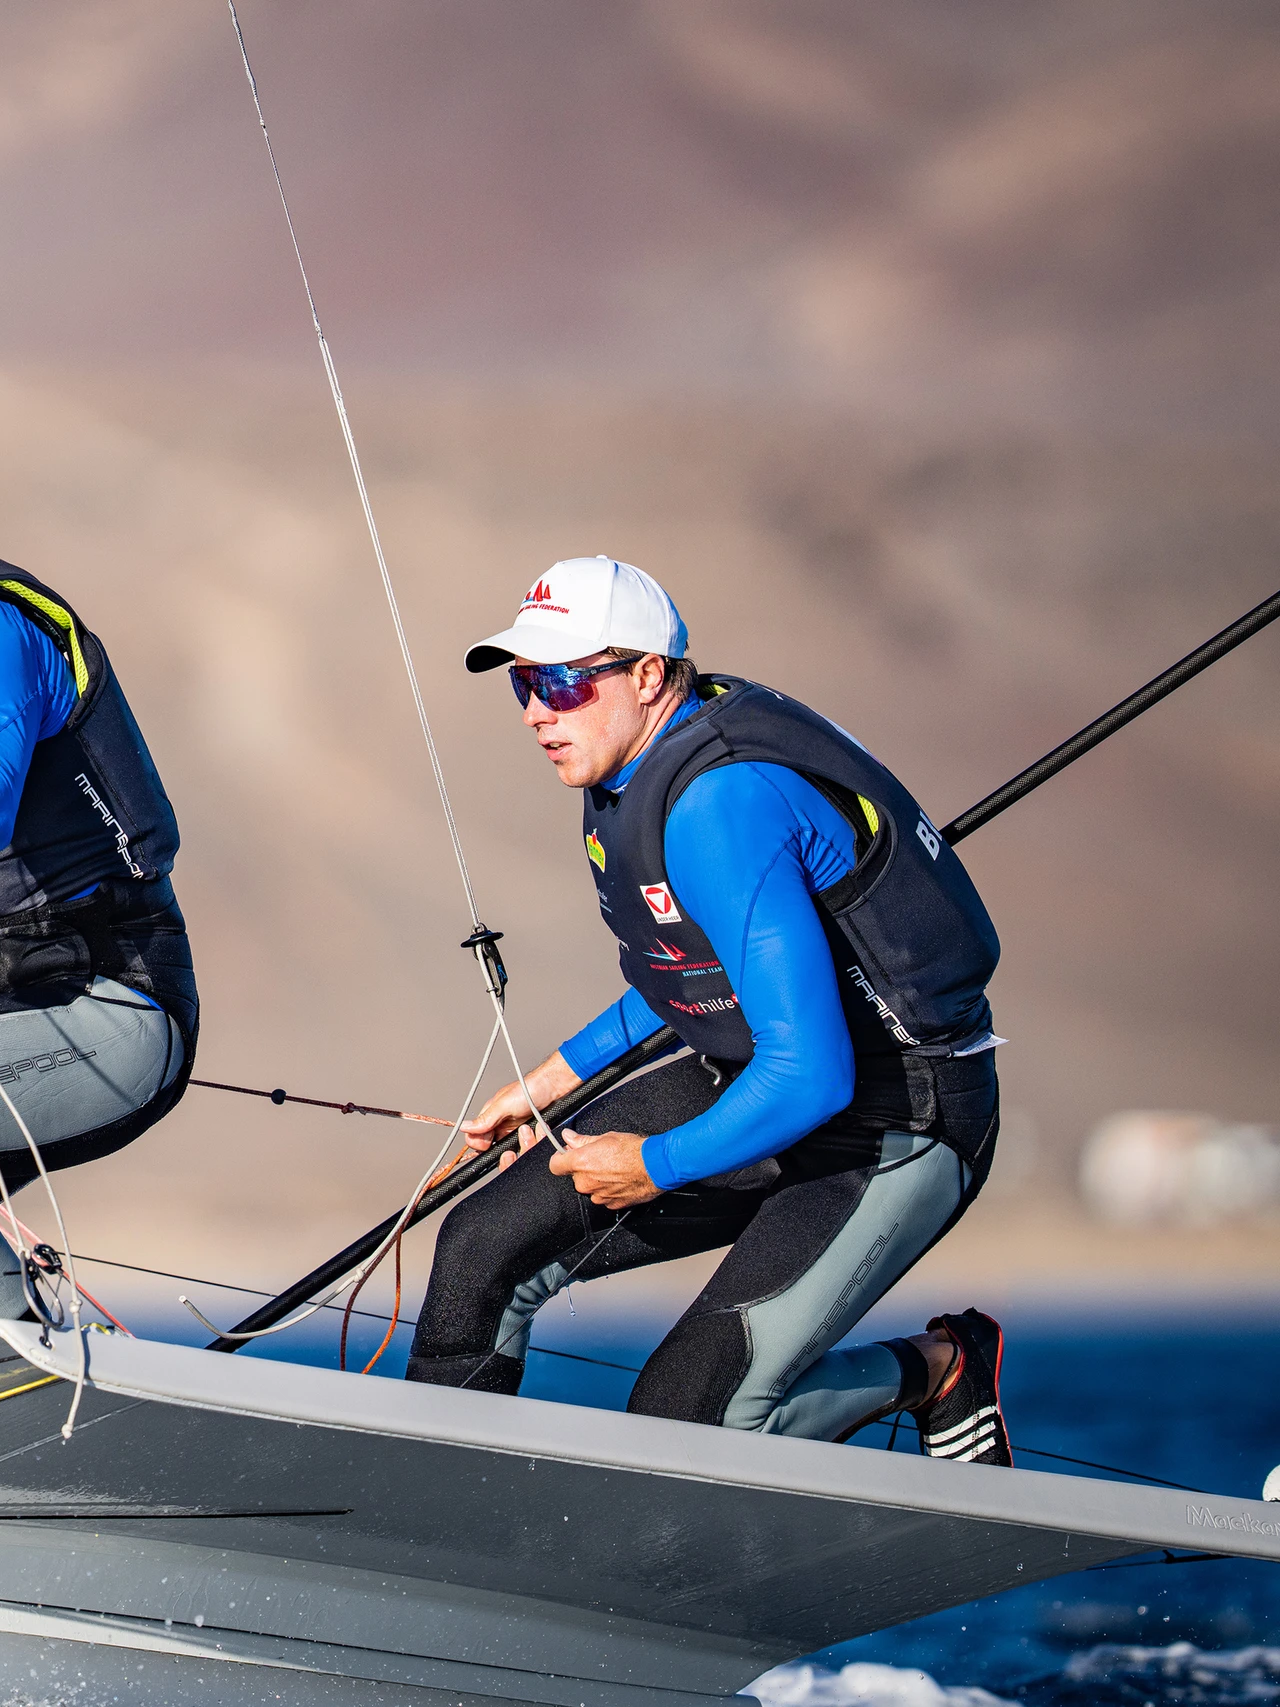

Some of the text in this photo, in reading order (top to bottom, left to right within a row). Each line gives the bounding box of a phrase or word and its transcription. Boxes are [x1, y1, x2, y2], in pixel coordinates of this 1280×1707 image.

[682, 966, 724, 977] NATIONAL TEAM
[765, 1222, 900, 1400] MARINEPOOL
